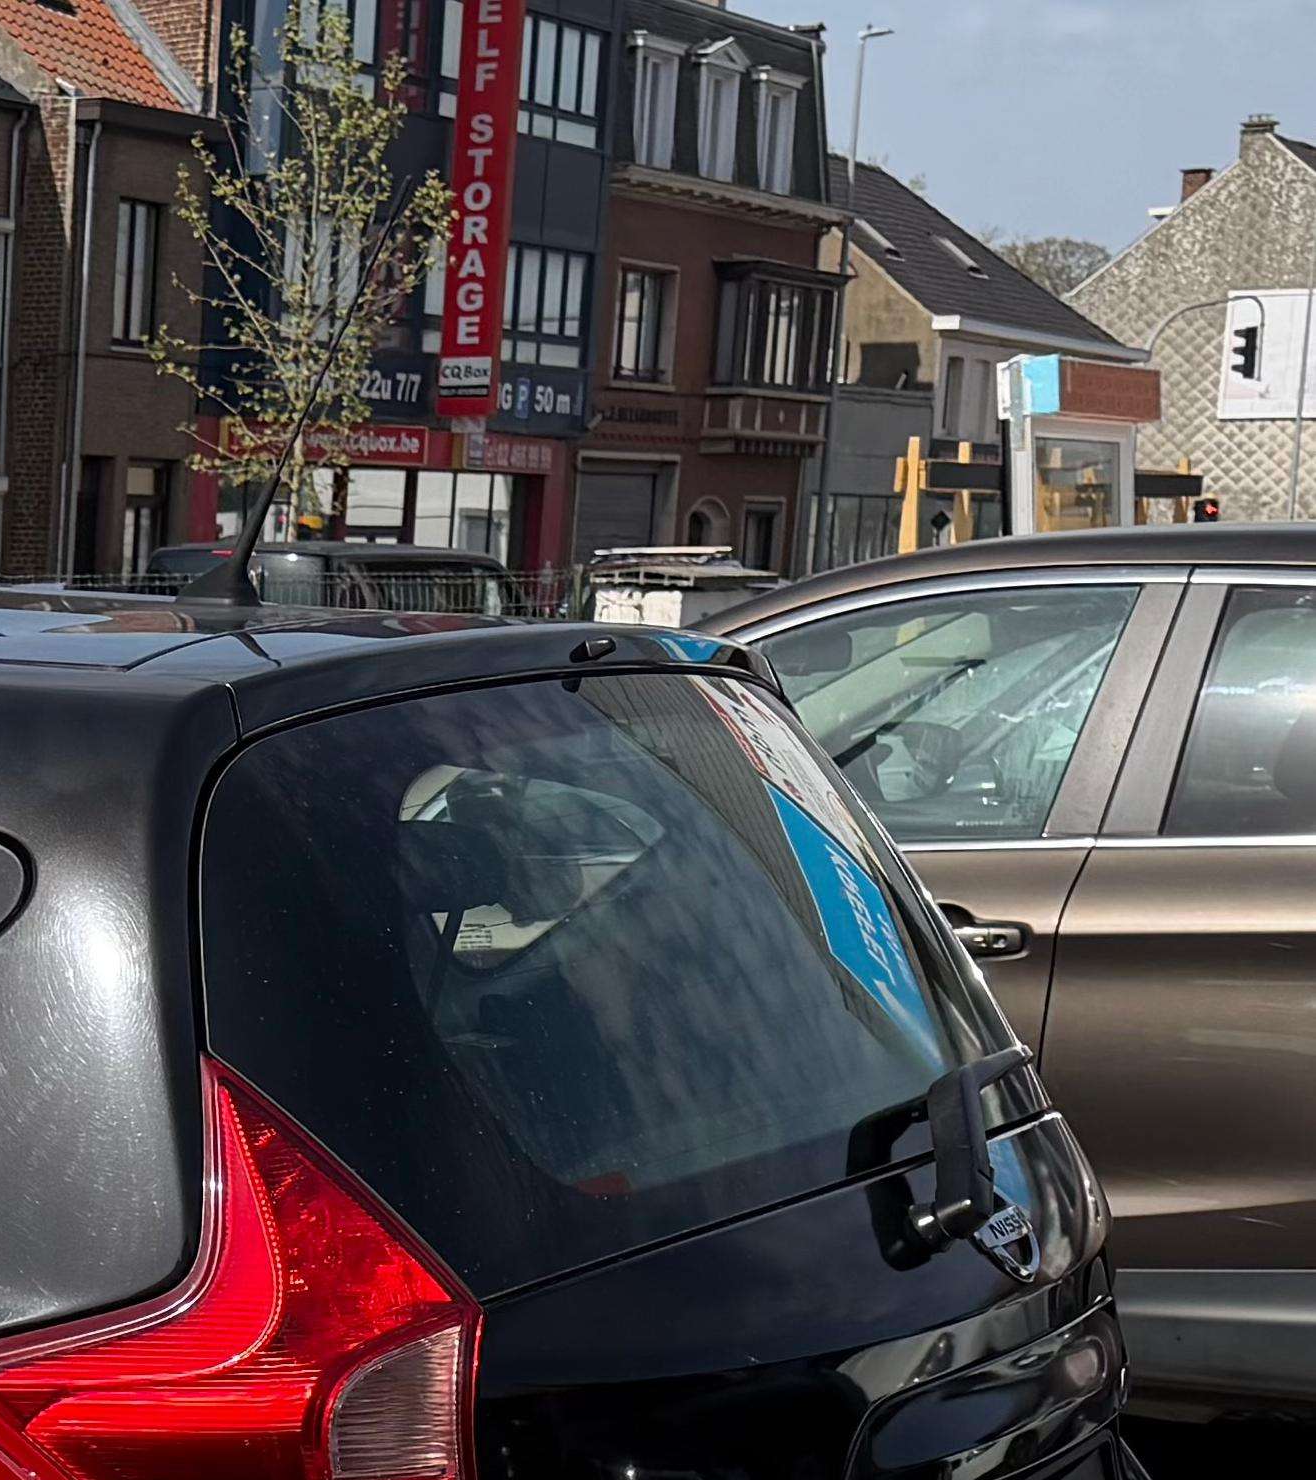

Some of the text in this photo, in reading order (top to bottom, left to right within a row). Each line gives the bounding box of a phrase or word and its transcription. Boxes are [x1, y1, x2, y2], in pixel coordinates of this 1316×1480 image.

[455, 0, 502, 345] ELF STORAGE
[396, 372, 421, 402] 7/7
[534, 385, 554, 413] 50
[556, 394, 571, 414] m
